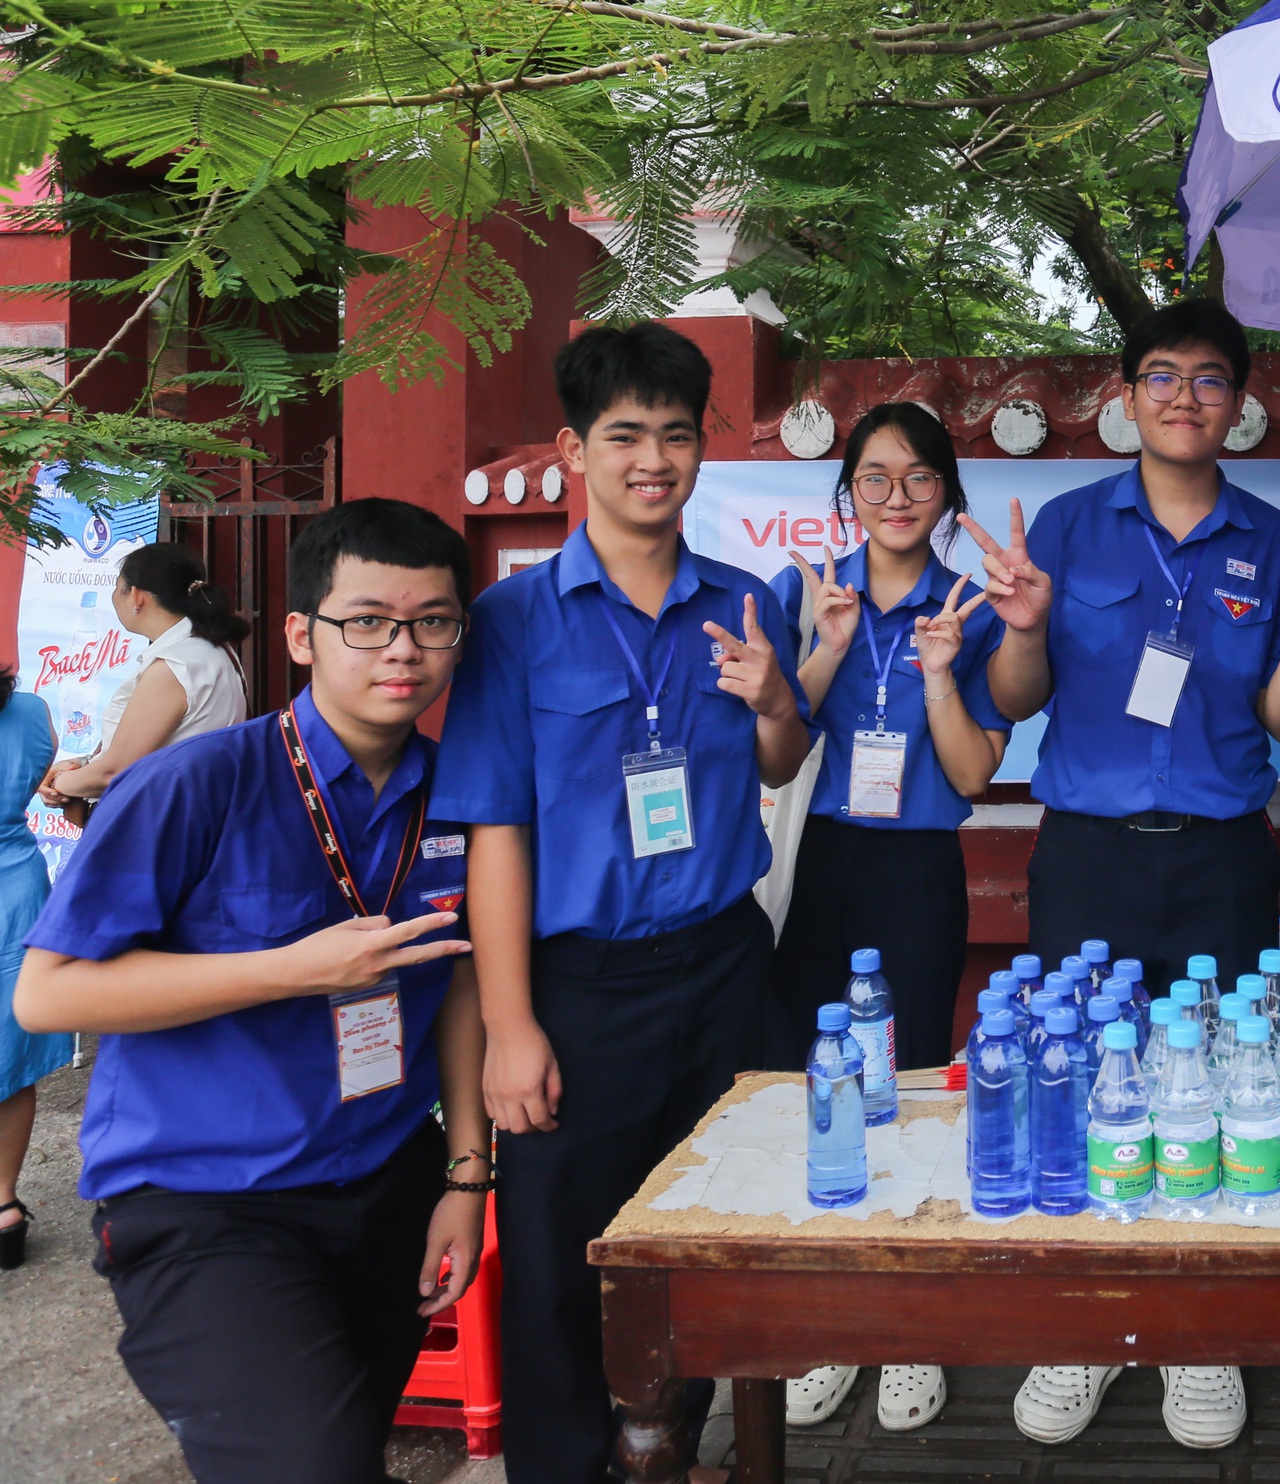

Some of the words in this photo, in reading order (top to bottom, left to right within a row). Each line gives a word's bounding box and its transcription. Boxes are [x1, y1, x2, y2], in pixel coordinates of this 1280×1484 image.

[742, 511, 865, 547] viett
[43, 569, 68, 584] NƯỚC
[69, 568, 93, 586] UỐNG
[33, 641, 97, 695] Bạch
[96, 628, 132, 670] Mã
